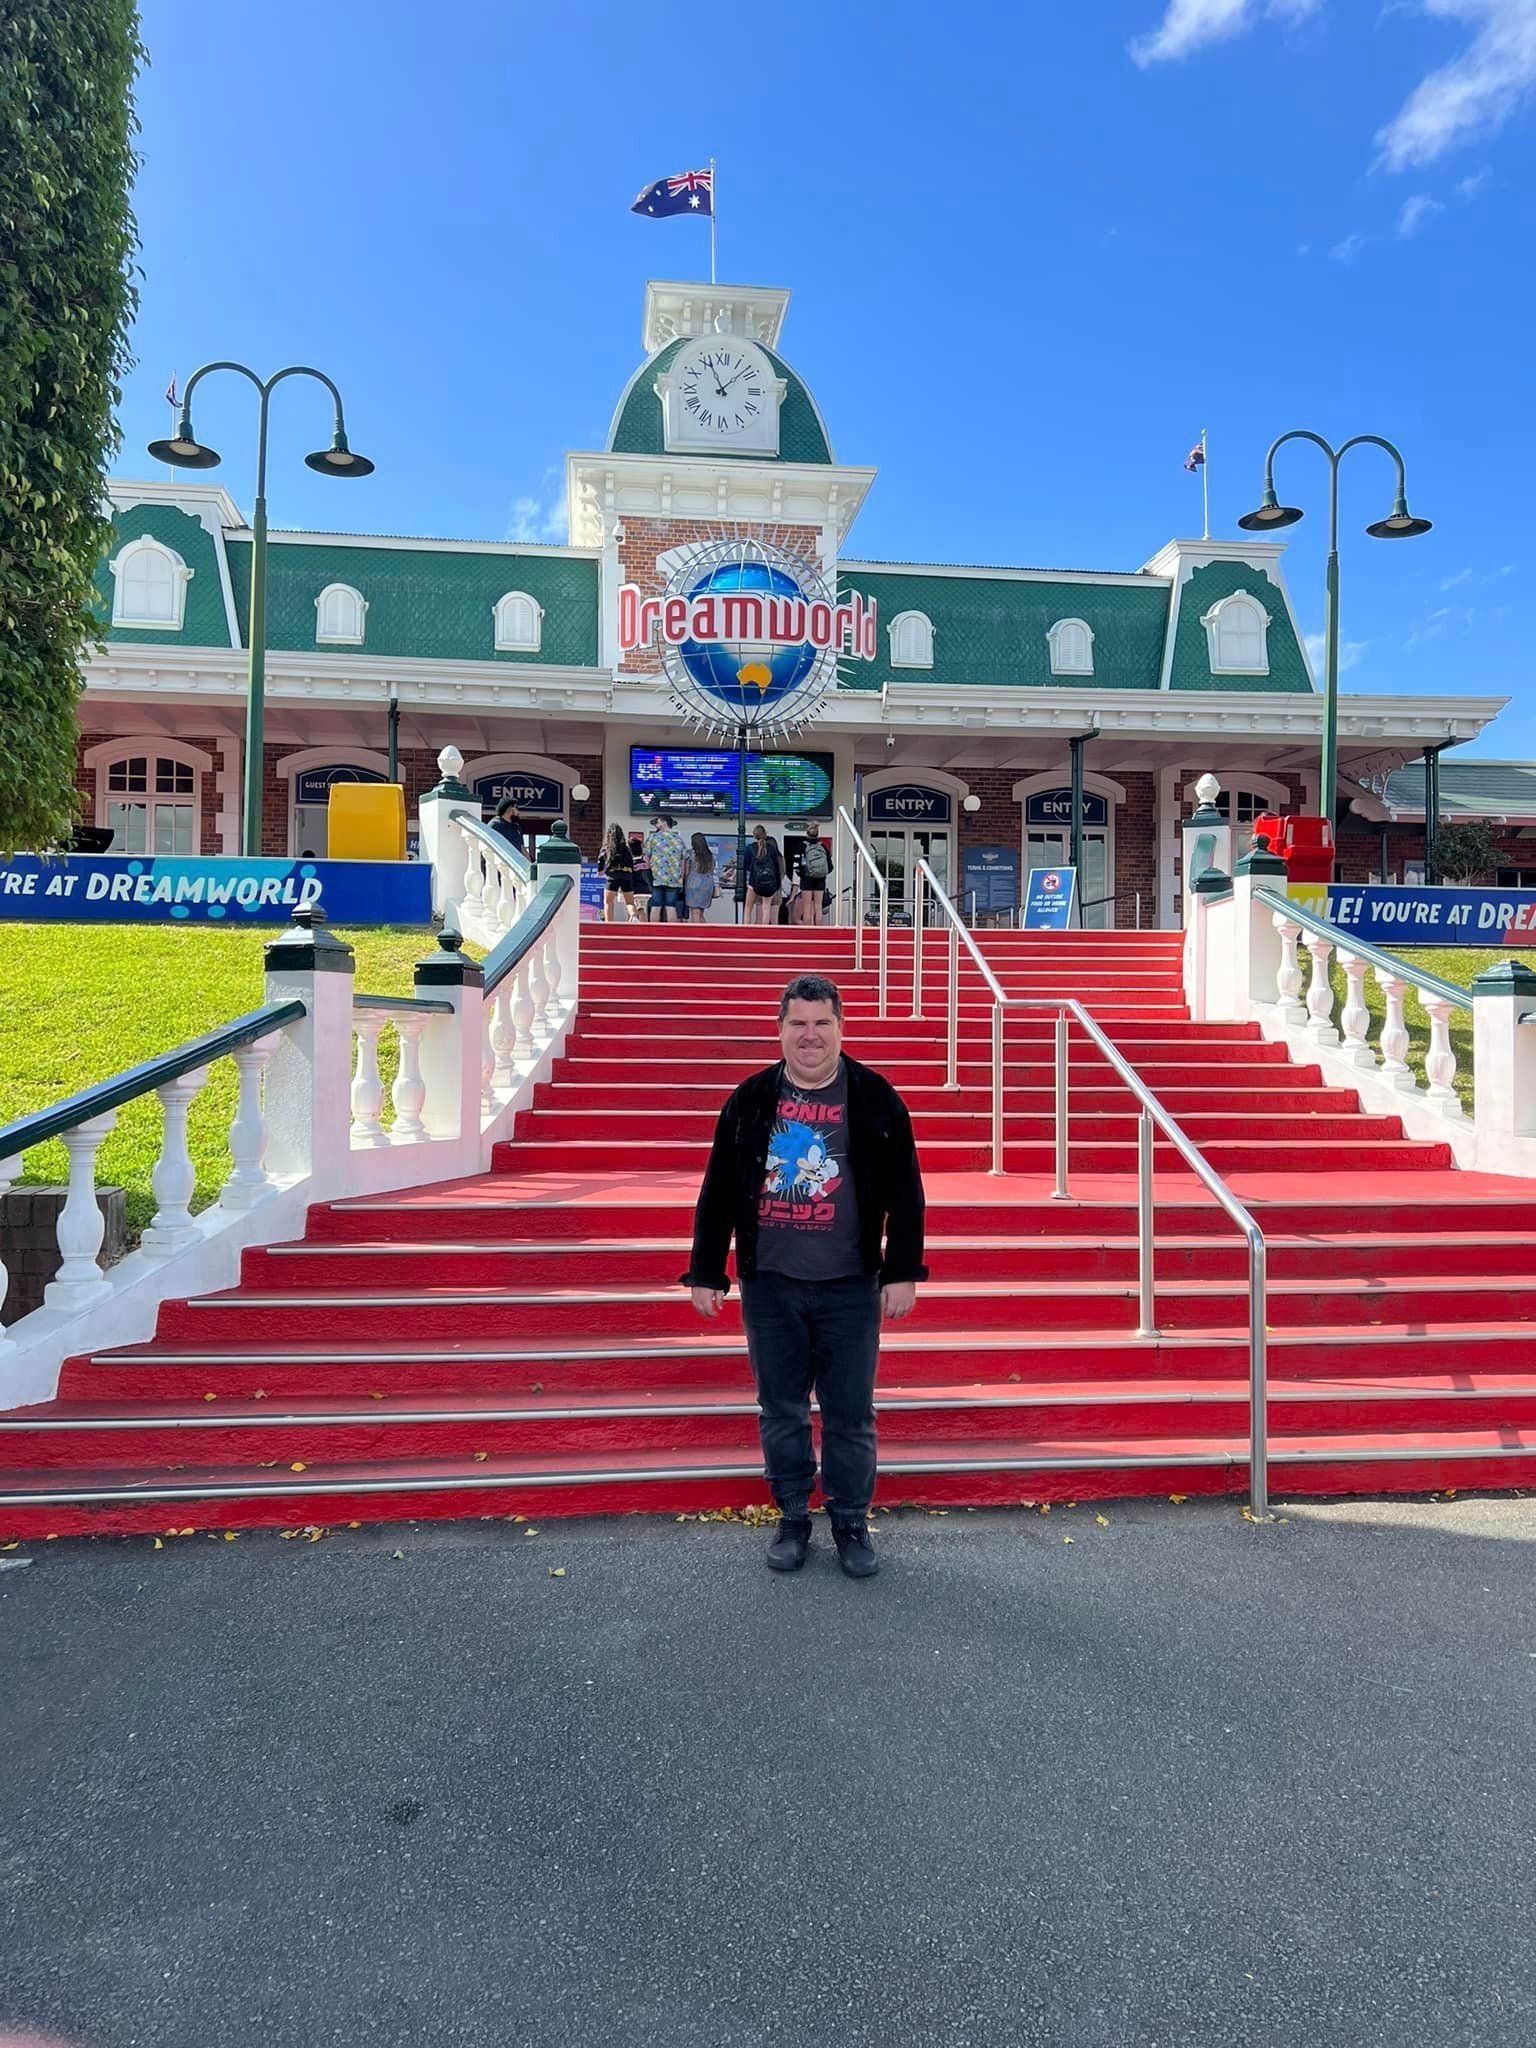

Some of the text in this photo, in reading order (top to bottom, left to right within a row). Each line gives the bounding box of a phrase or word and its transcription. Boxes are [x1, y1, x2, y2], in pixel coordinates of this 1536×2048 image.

[715, 353, 730, 366] XII
[734, 359, 742, 370] I
[687, 367, 702, 380] X
[743, 371, 756, 381] II
[684, 383, 697, 394] IX
[747, 388, 761, 396] III
[686, 396, 701, 414] VIII
[699, 409, 712, 426] VII
[718, 416, 728, 429] VI
[735, 413, 745, 426] V
[619, 584, 877, 661] Dreamworld
[305, 781, 326, 789] GUEST
[492, 786, 545, 801] ENTRY
[885, 799, 935, 811] ENTRY
[1043, 801, 1092, 815] ENTY
[45, 875, 78, 896] AT
[86, 873, 322, 905] DREAMWORLD
[1371, 901, 1441, 924] YOU'RE
[1446, 905, 1472, 926] AT
[777, 1101, 843, 1122] ONIC
